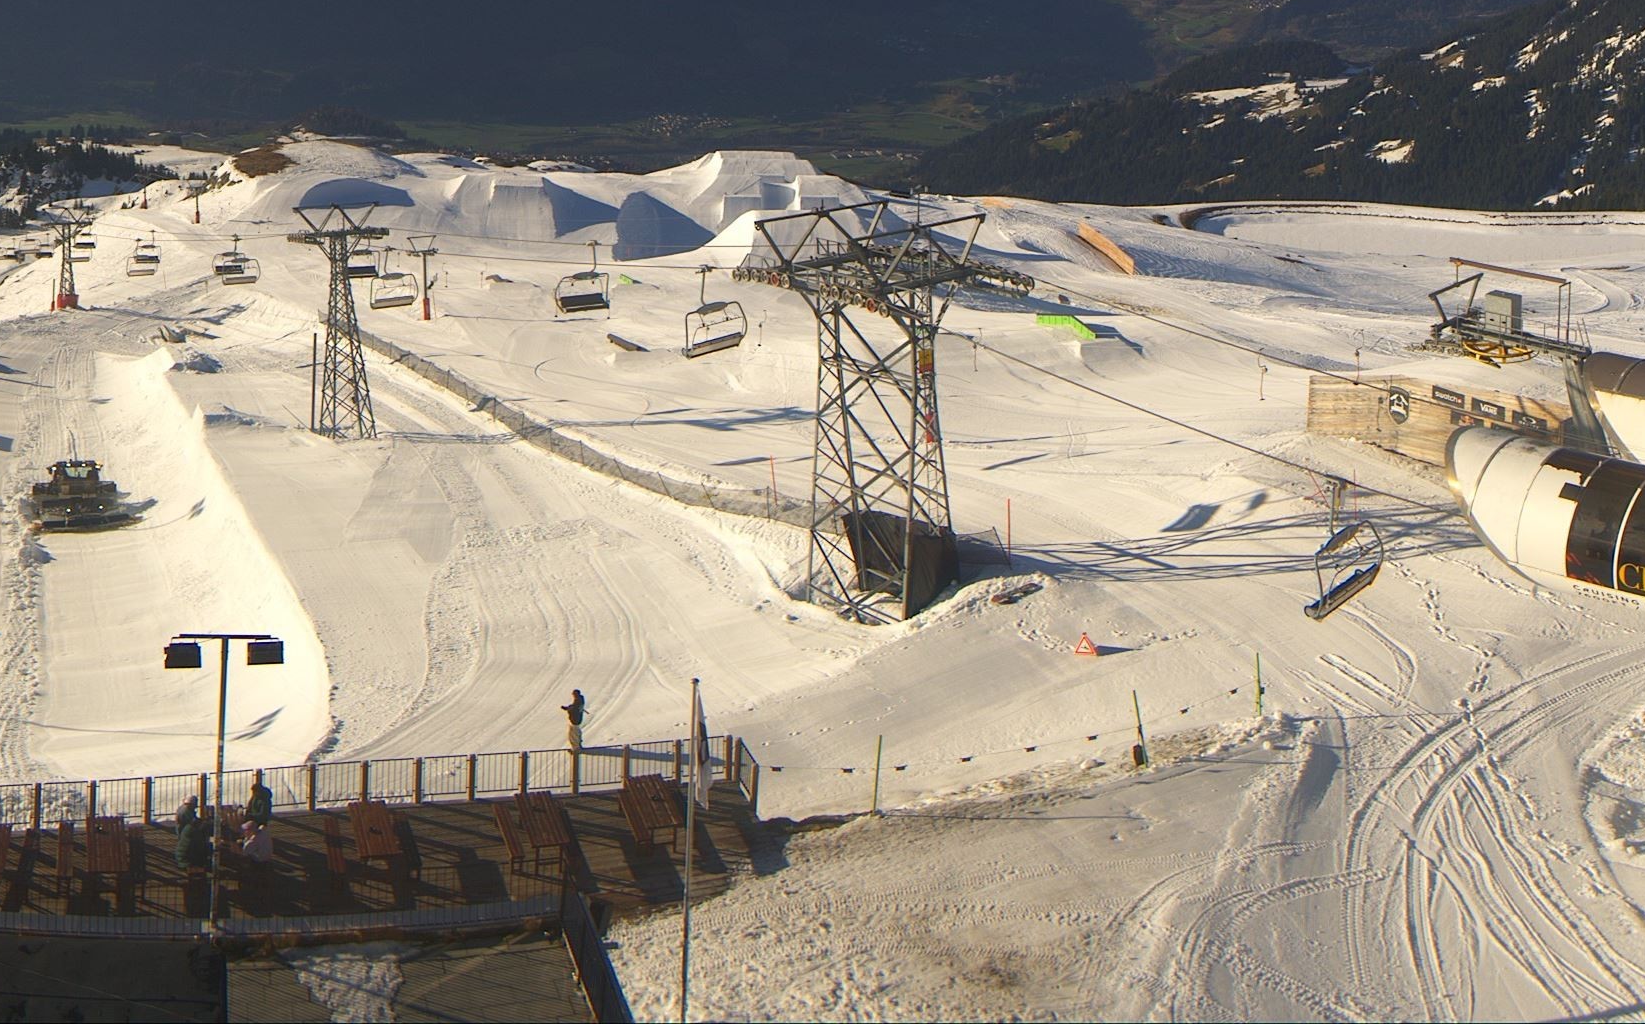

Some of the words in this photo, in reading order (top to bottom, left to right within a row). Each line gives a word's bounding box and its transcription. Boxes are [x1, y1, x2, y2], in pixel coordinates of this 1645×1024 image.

[1434, 391, 1458, 404] swatch
[1480, 403, 1498, 415] VANS
[1572, 584, 1640, 606] CRUISING
